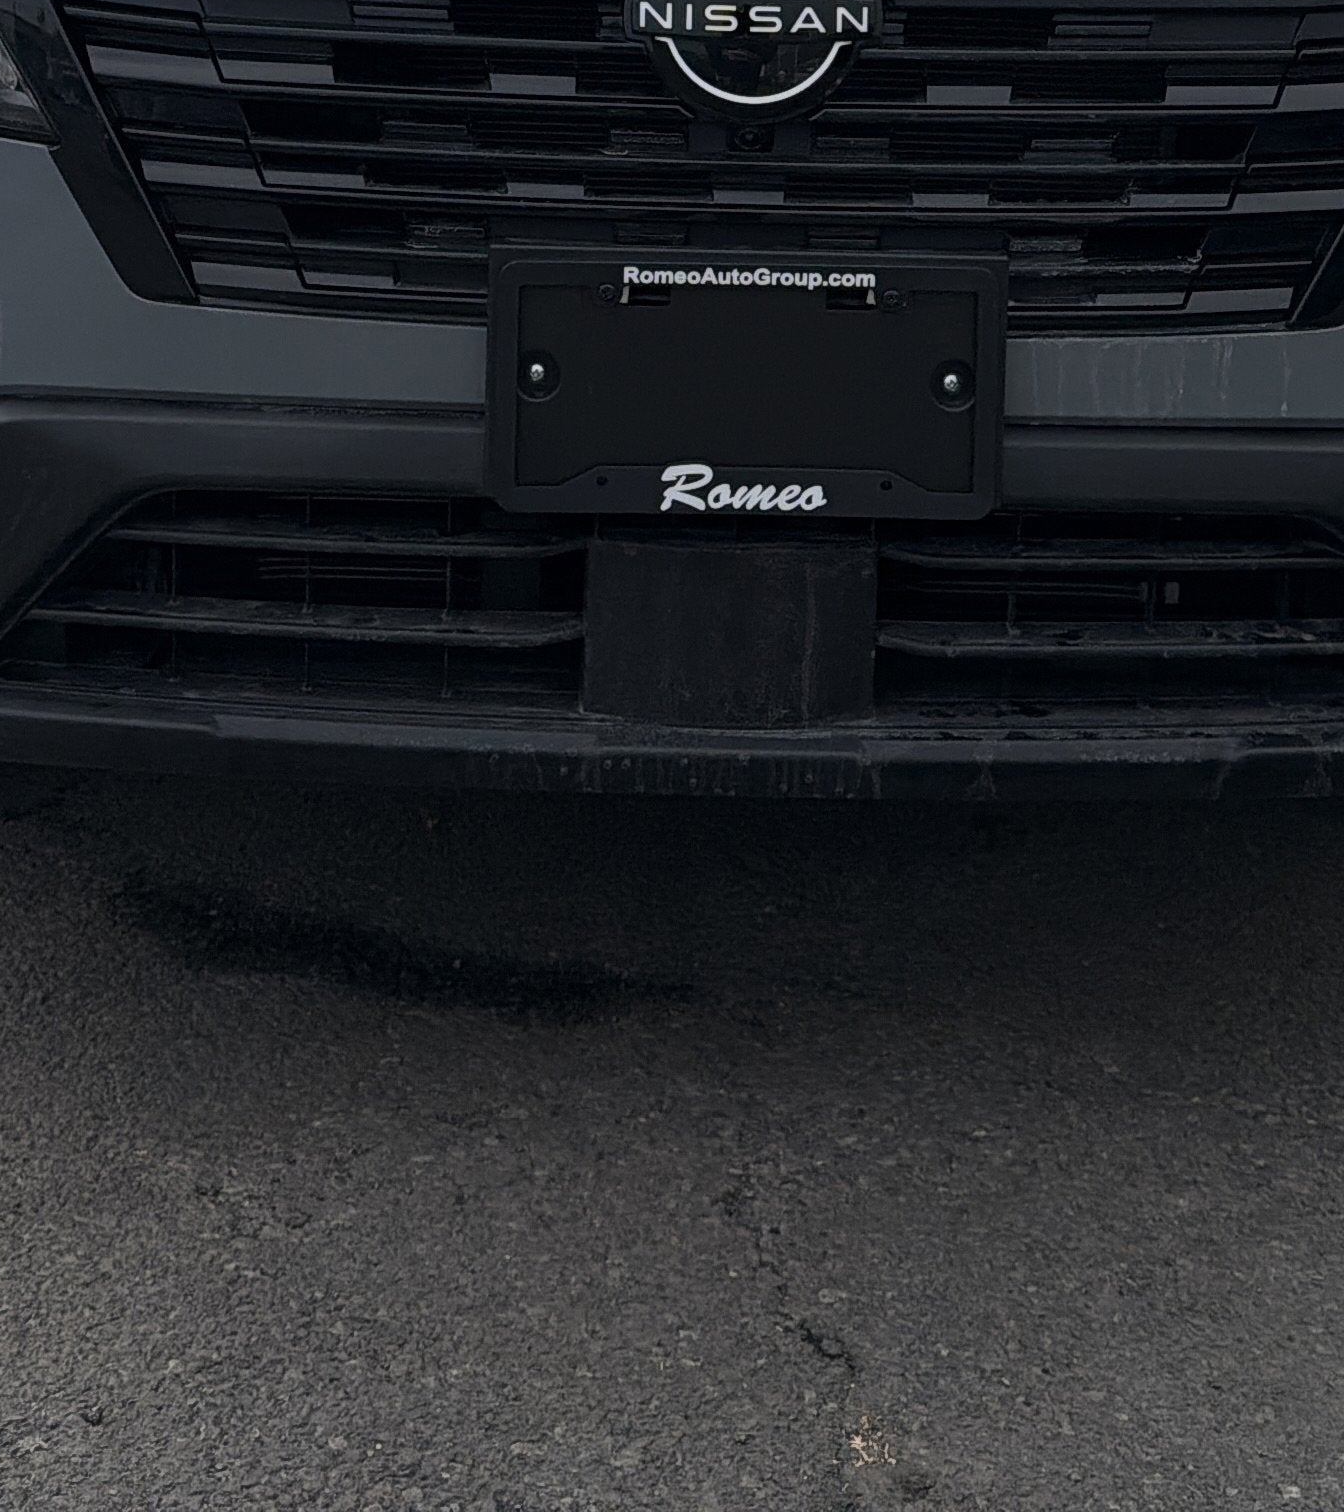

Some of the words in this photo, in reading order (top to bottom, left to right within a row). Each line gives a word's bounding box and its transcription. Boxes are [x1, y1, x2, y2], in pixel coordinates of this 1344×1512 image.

[639, 1, 869, 33] NISSAN
[623, 266, 876, 291] RomeoAutoGroup.com
[660, 463, 828, 512] Romeo
